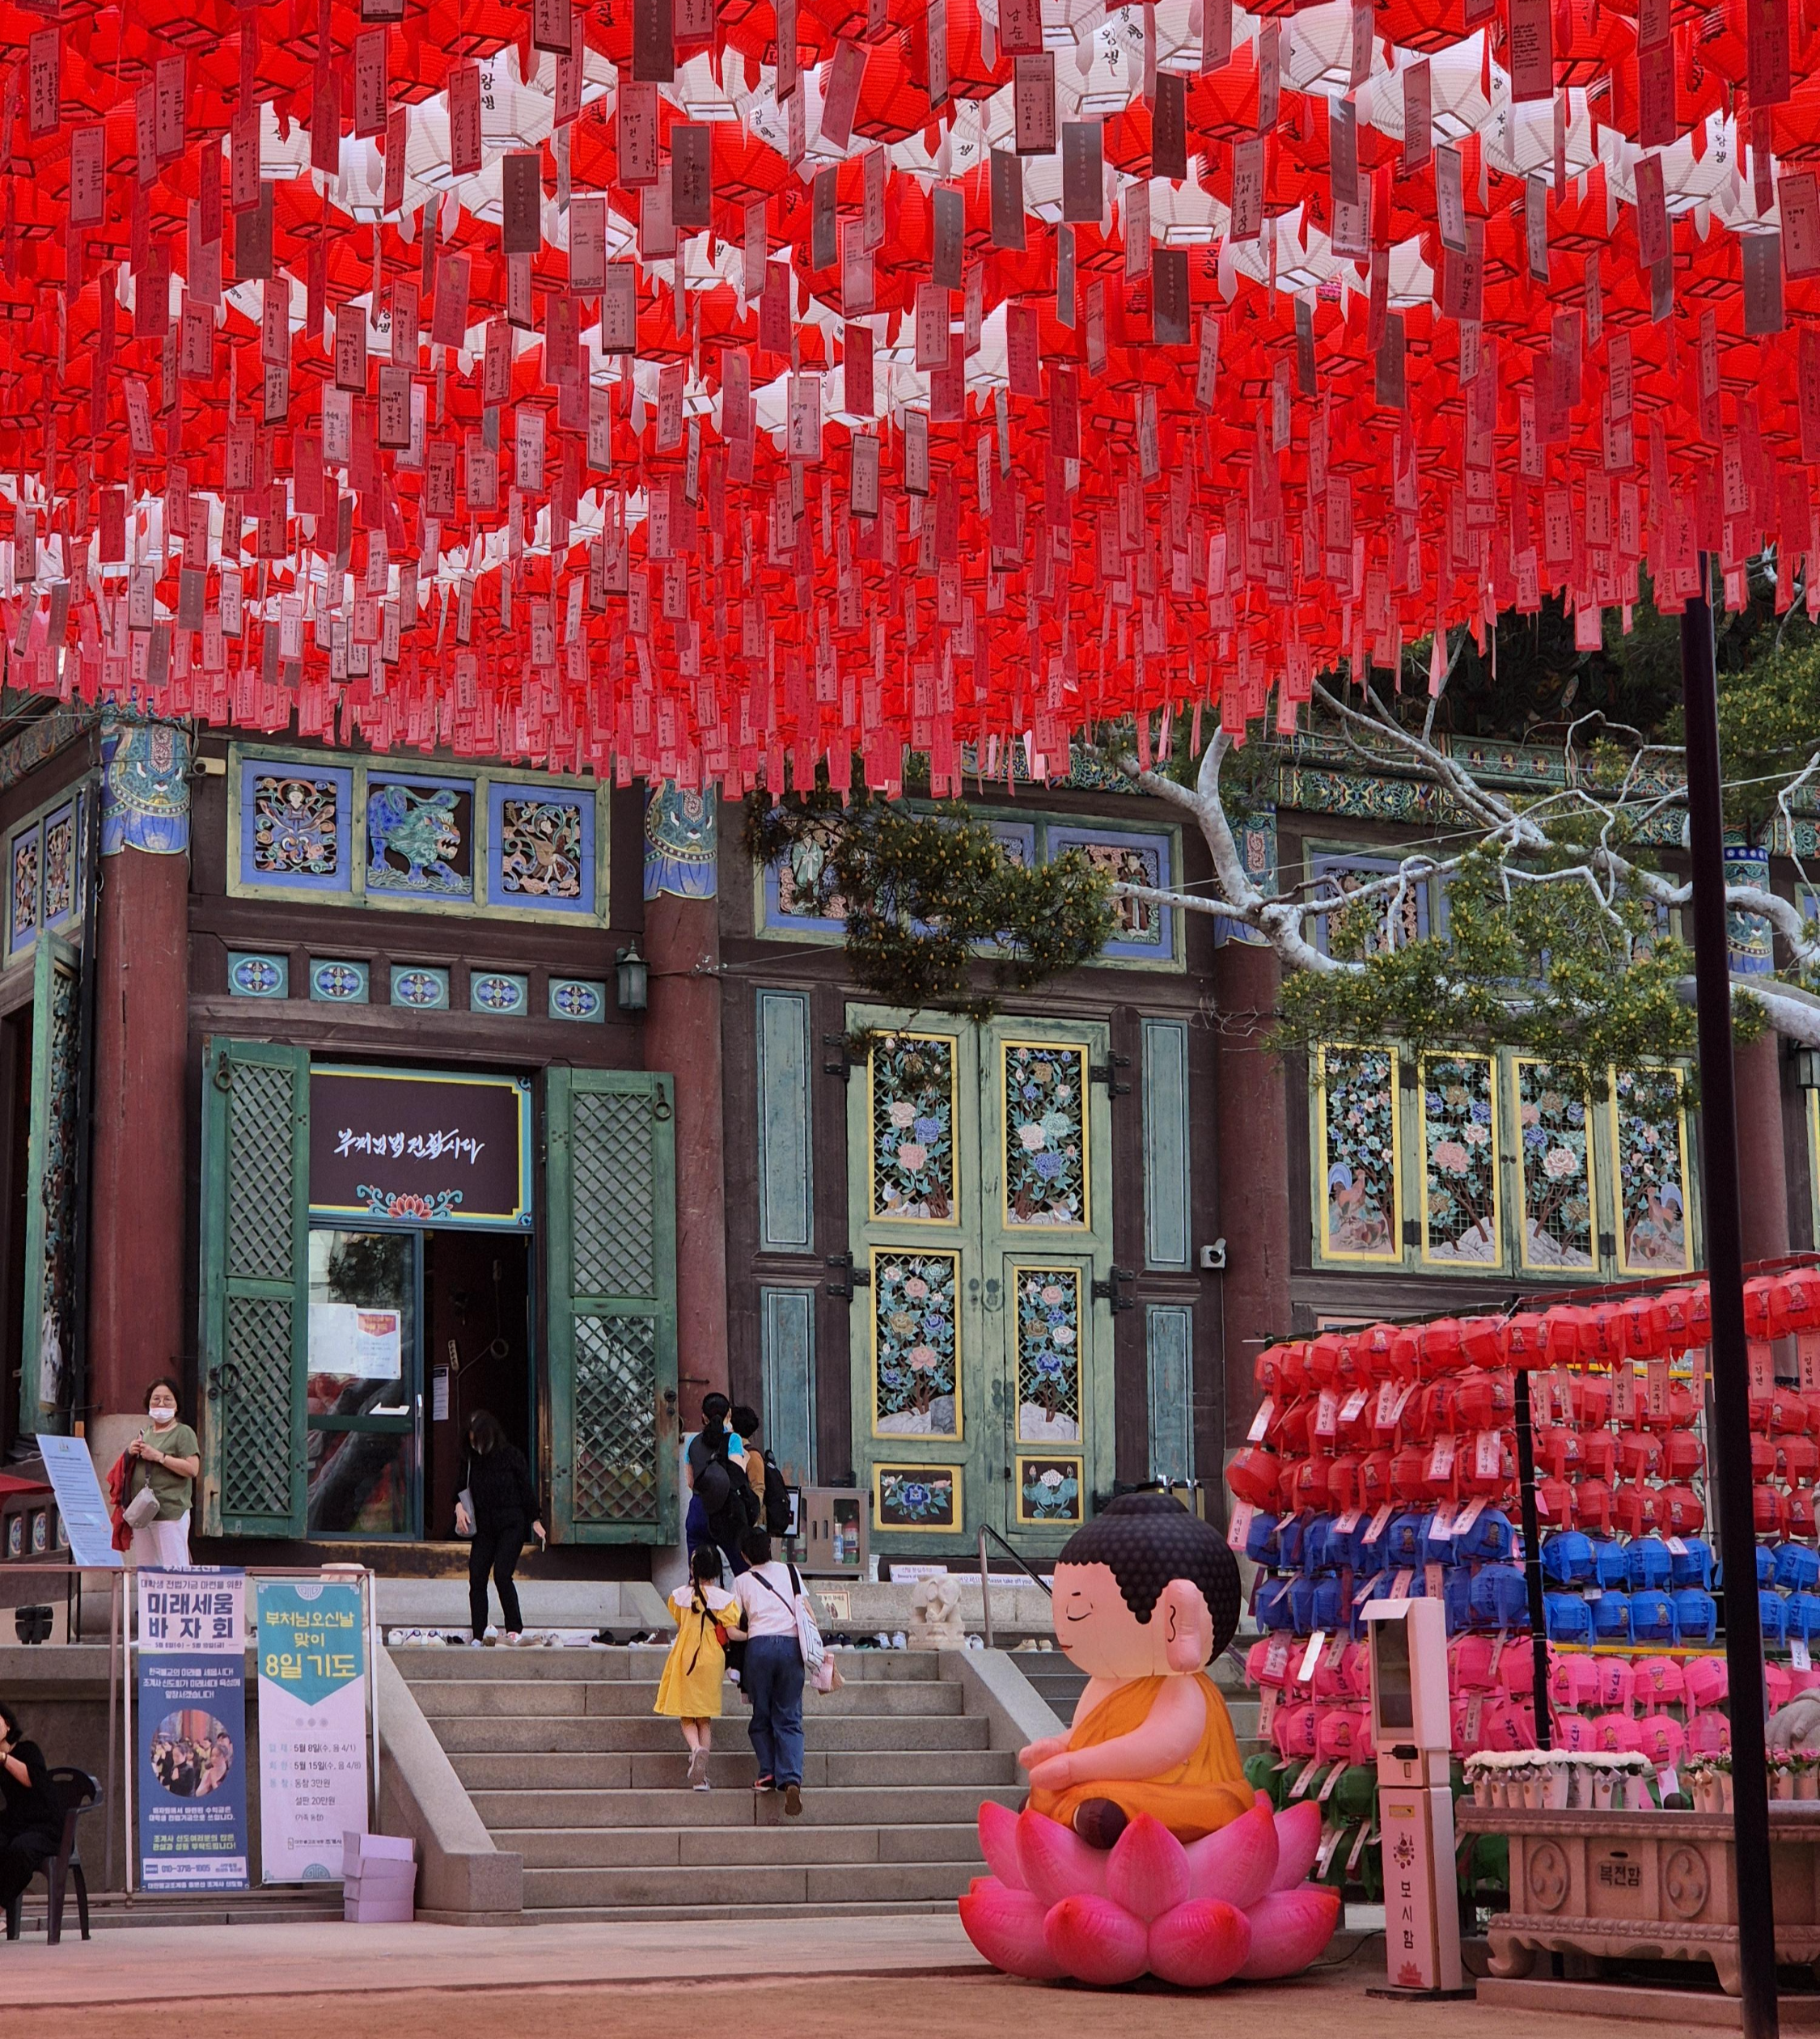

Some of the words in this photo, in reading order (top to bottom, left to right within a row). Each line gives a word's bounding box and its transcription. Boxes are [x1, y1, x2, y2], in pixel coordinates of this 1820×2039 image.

[141, 1580, 163, 1589] 대학생
[226, 1580, 243, 1589] 위한
[147, 1593, 234, 1615] 미래세움
[265, 1610, 355, 1627] 부처님오신날
[294, 1632, 325, 1648] 맞이
[265, 1652, 303, 1679] 8일
[307, 1652, 357, 1678] 기도
[294, 1744, 306, 1753] 5월
[294, 1762, 307, 1770] 5월
[311, 1796, 336, 1806] 20만원
[1599, 1864, 1641, 1888] 복전함
